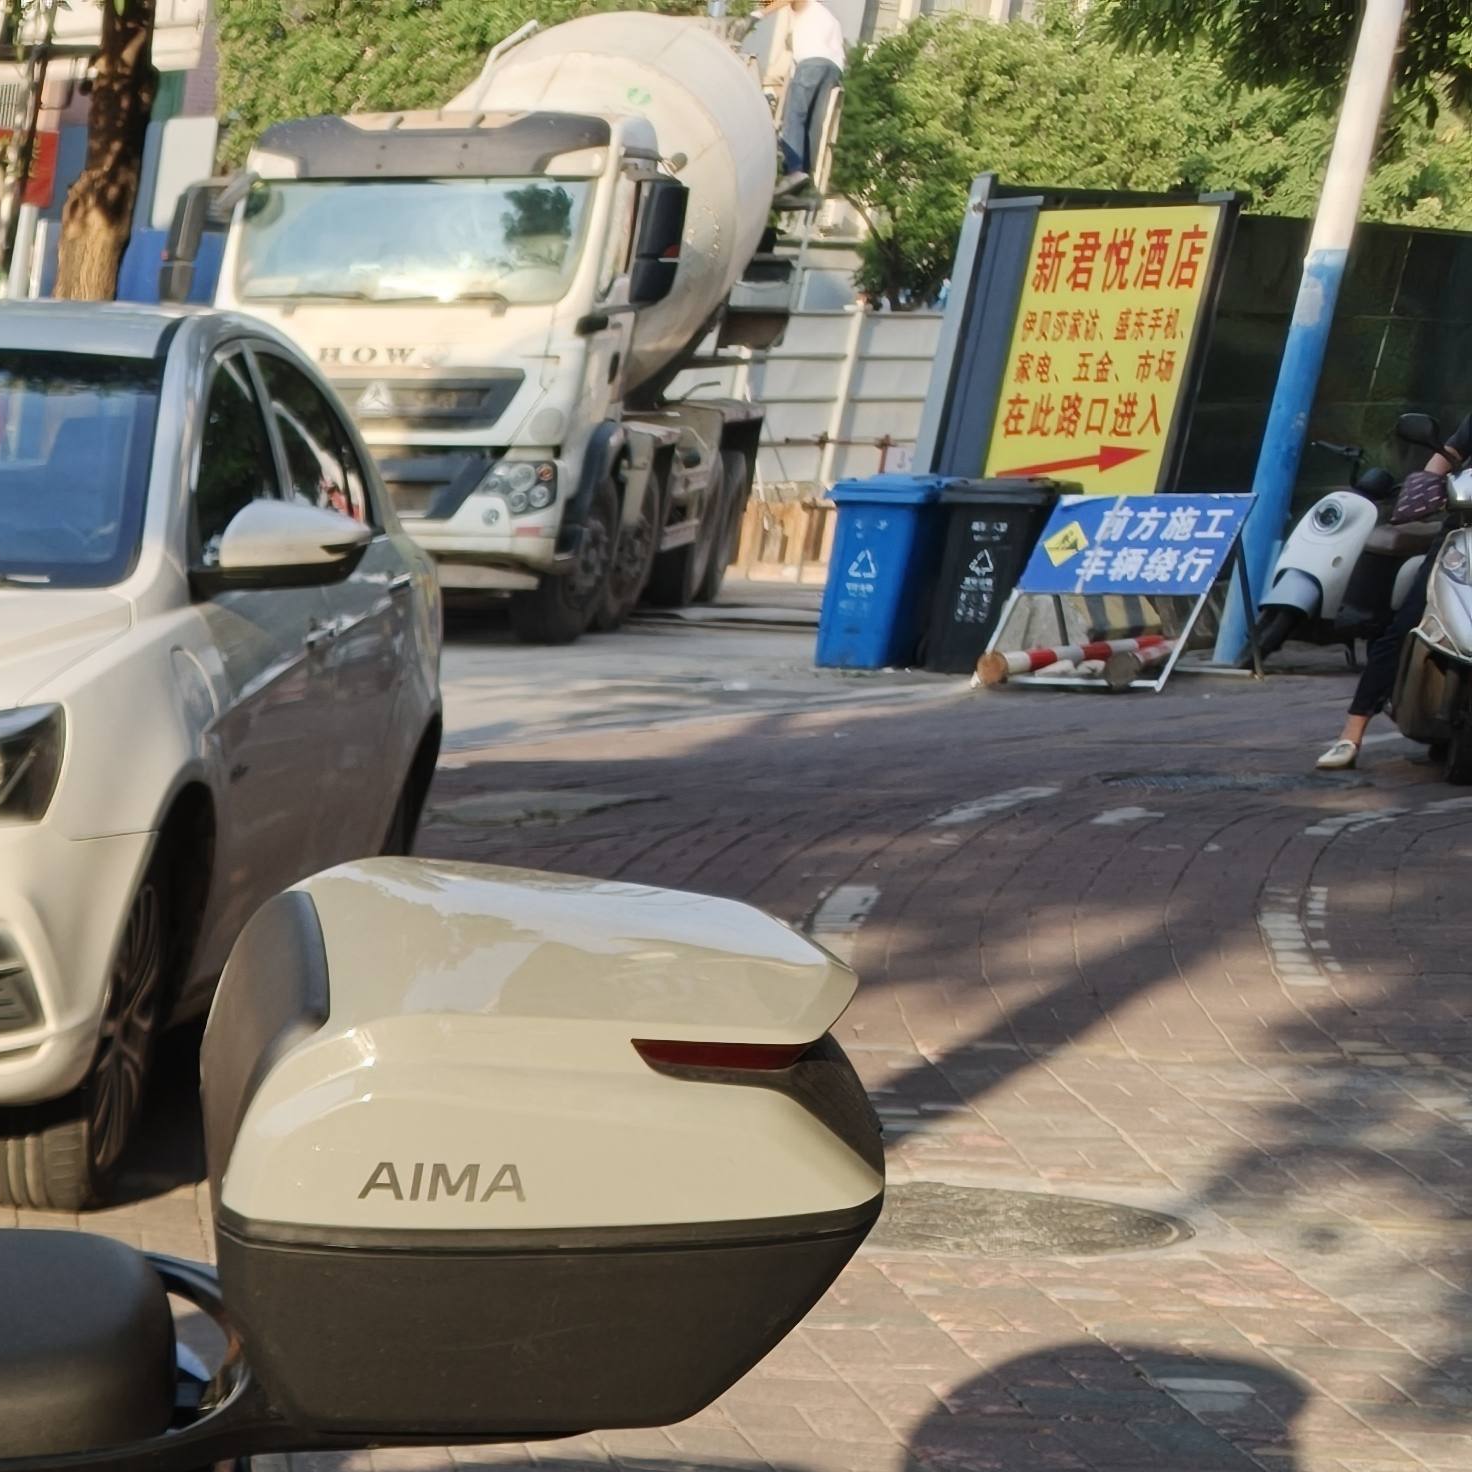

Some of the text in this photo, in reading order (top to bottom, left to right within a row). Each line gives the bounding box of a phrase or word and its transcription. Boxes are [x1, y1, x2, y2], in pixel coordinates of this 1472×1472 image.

[1032, 224, 1209, 293] 新君悦酒店
[1002, 392, 1162, 438] 在此路口进入
[1094, 506, 1235, 542] 前方施工
[1075, 546, 1216, 582] 车辆绕行
[357, 1161, 527, 1203] AIMA
